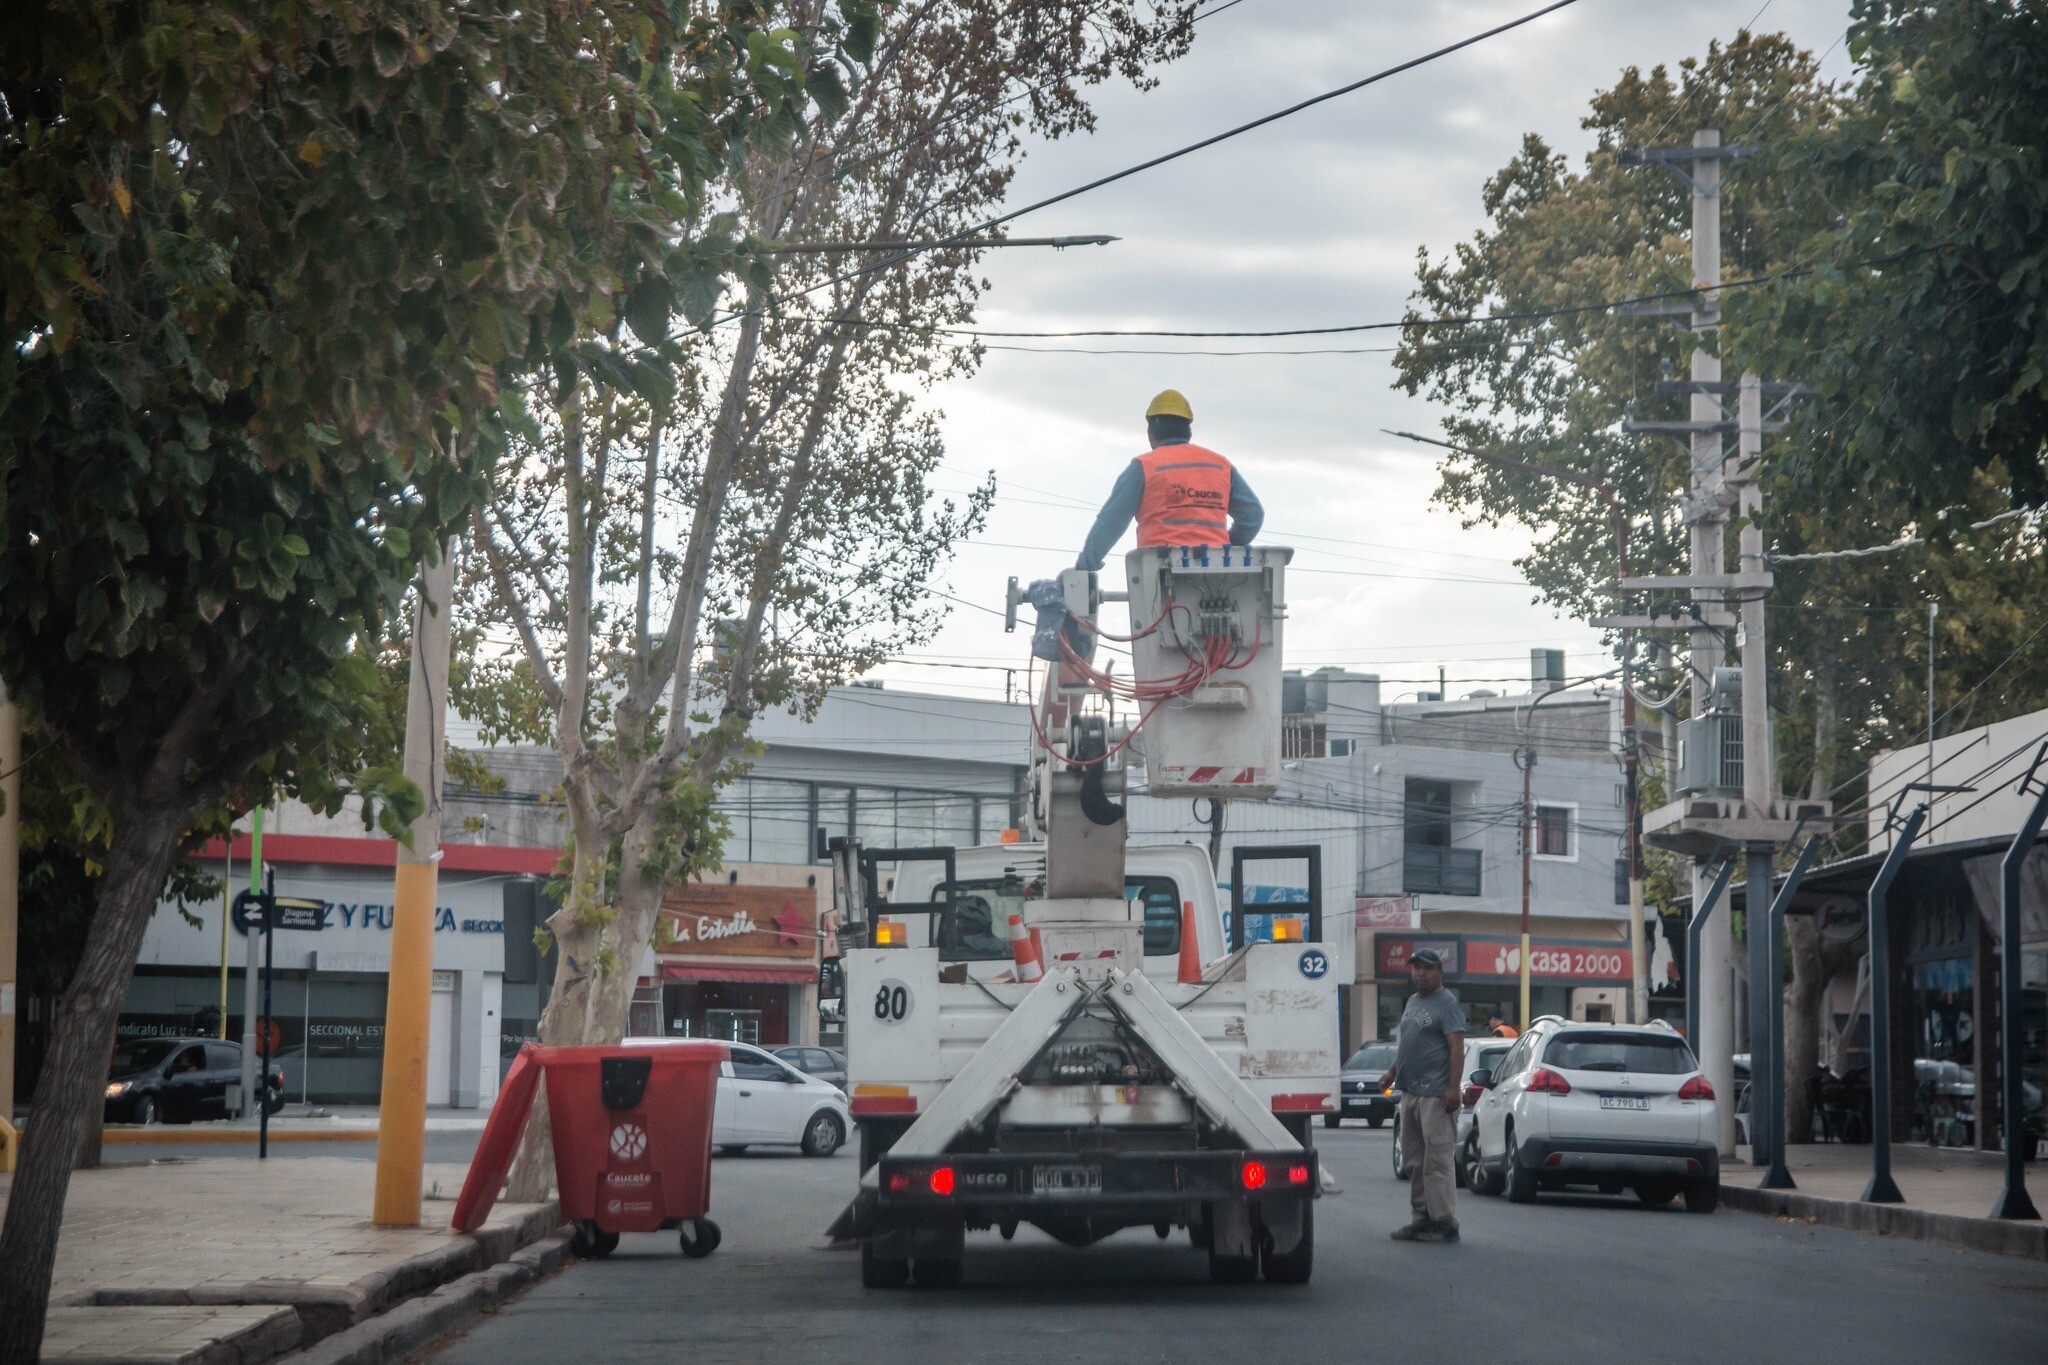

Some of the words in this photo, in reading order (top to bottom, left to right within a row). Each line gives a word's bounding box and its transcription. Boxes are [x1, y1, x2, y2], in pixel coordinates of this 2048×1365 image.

[284, 908, 314, 917] Diagonal
[340, 904, 358, 928] Y
[282, 916, 316, 926] Sarmiento
[696, 910, 757, 940] Estrella
[1303, 956, 1325, 973] 32
[1529, 951, 1571, 973] casa
[1574, 953, 1622, 974] 2000
[875, 985, 907, 1020] 80
[117, 1021, 158, 1036] indicato
[160, 1023, 177, 1036] Luz
[309, 1025, 364, 1036] SECCIONAL
[366, 1025, 385, 1036] EST
[1603, 1098, 1614, 1107] AC
[1616, 1098, 1634, 1108] 790
[1636, 1099, 1648, 1109] LB
[607, 1173, 651, 1182] Caucete
